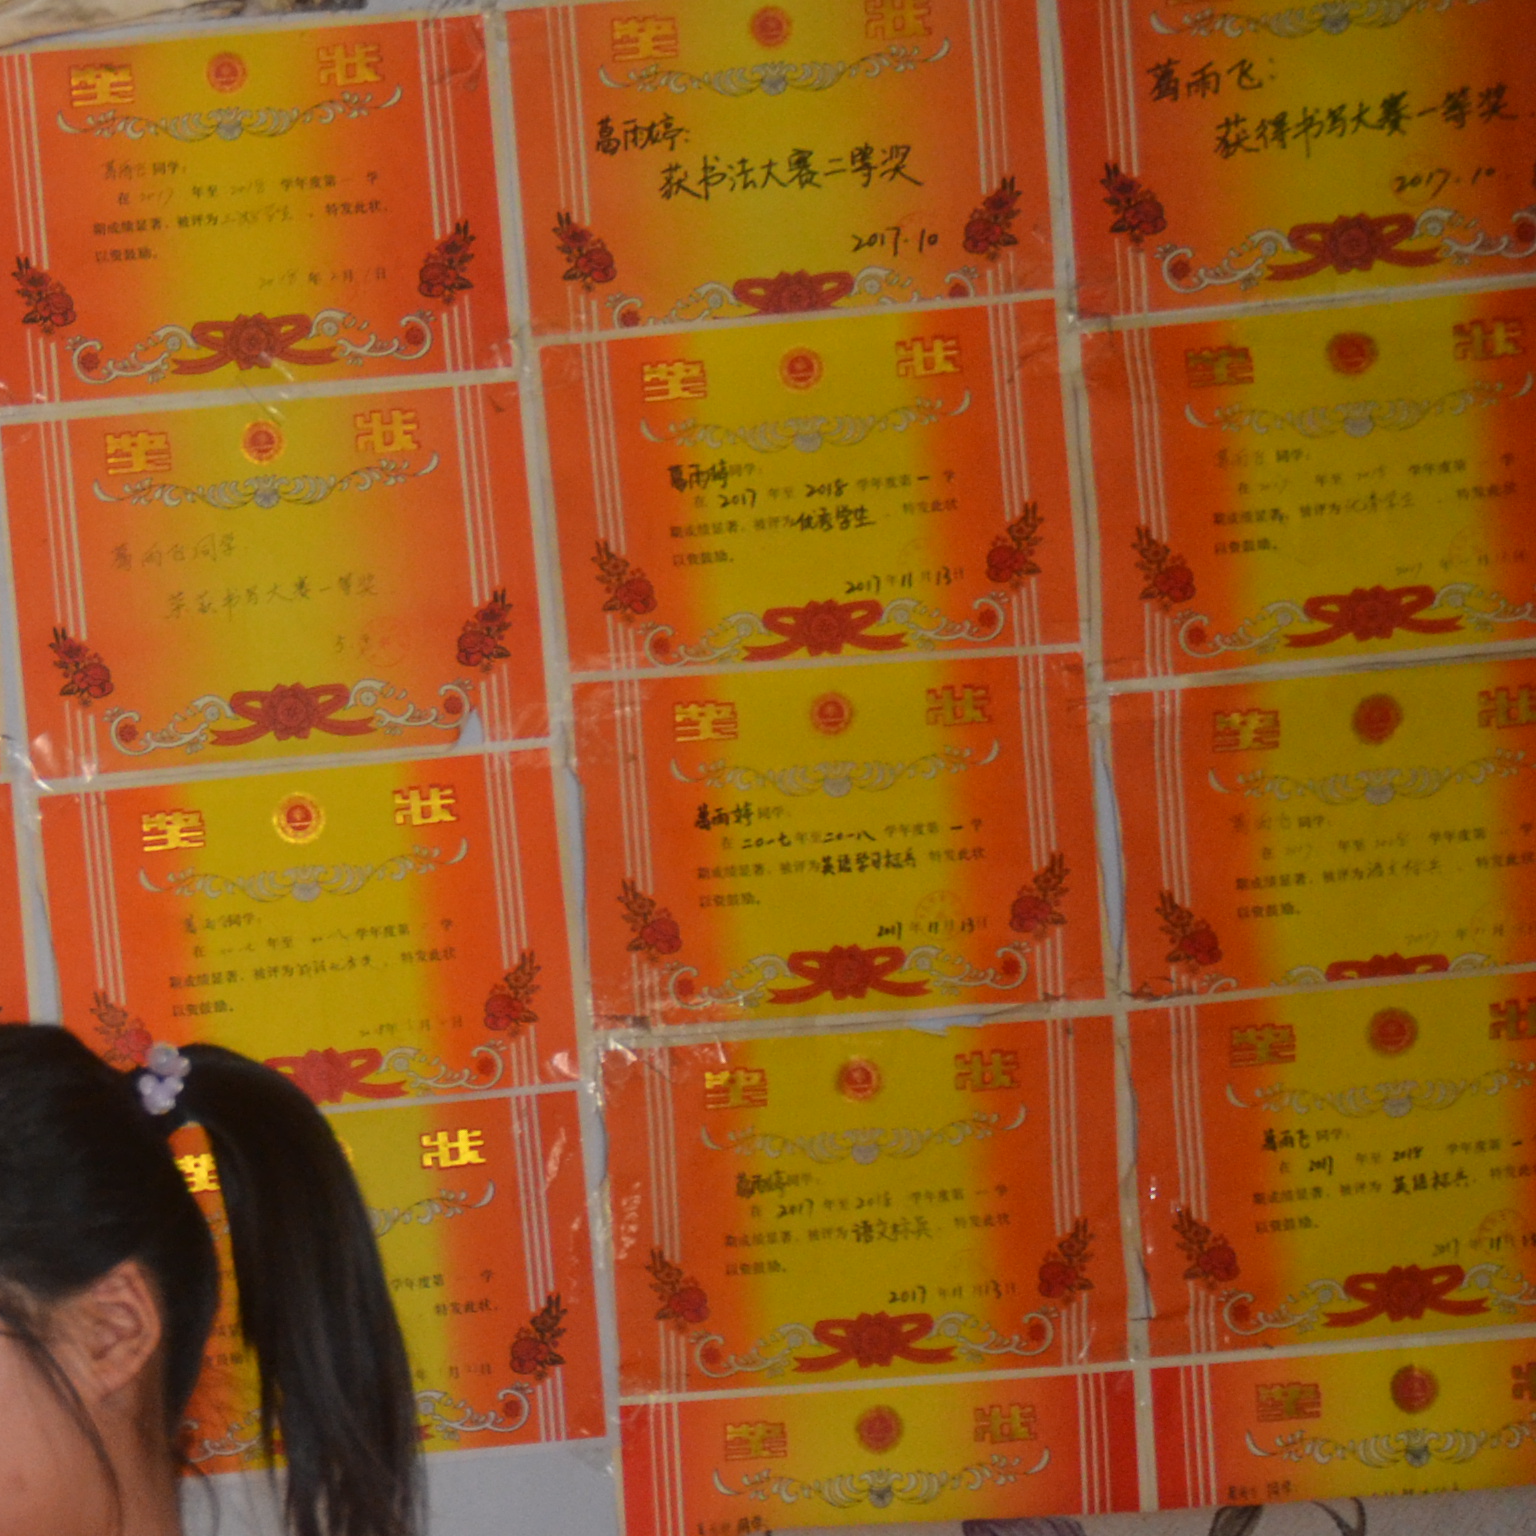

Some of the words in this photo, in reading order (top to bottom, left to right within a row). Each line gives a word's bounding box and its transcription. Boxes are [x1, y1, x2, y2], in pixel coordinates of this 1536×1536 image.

[865, 0, 933, 41] 状
[316, 43, 383, 86] 状
[659, 144, 925, 201] 获书法大赛二等奖
[894, 335, 961, 379] 状
[354, 408, 422, 453] 状
[718, 488, 758, 509] 2017
[805, 479, 848, 498] 2018
[926, 683, 992, 727] 状
[392, 784, 457, 827] 状
[954, 1048, 1021, 1093] 状
[420, 1128, 487, 1169] 状
[778, 1199, 814, 1218] 2017
[855, 1191, 892, 1209] 2018
[973, 1403, 1035, 1443] 状
